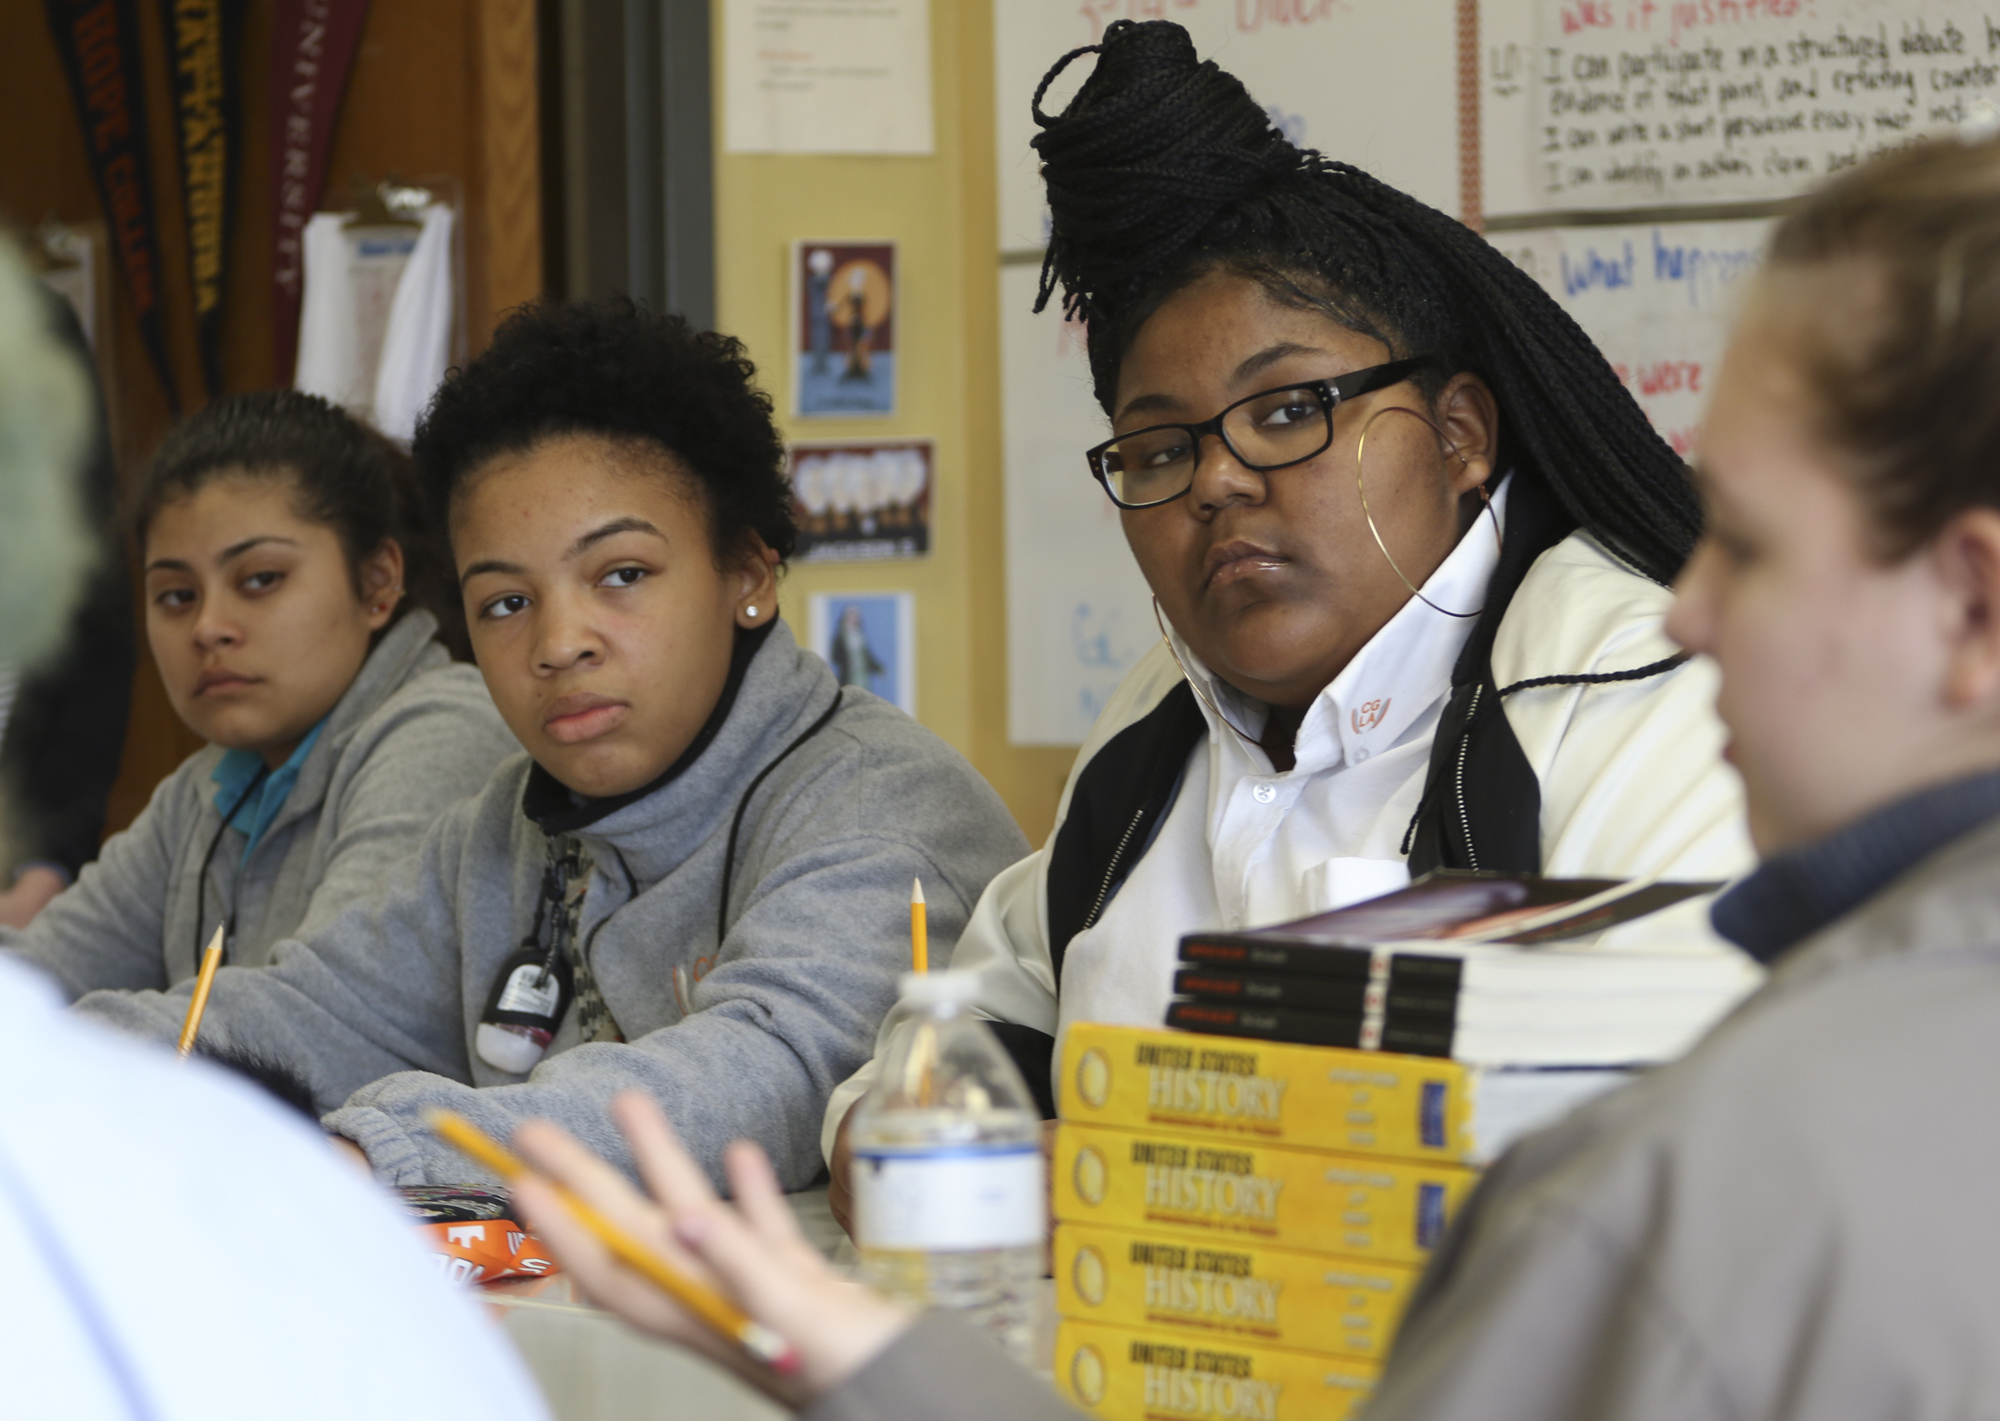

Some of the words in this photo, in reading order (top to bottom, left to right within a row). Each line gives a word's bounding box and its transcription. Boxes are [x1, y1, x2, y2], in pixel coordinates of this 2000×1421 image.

[1572, 51, 1611, 82] can
[1136, 1042, 1192, 1073] UNITED
[1198, 1048, 1259, 1077] STATES
[1148, 1066, 1286, 1121] HISTORY
[1131, 1141, 1187, 1173] UNITED
[1194, 1147, 1256, 1177] STATES
[1144, 1165, 1283, 1221] HISTORY
[1130, 1242, 1186, 1273] UNITED
[1192, 1248, 1253, 1277] STATES
[1144, 1265, 1281, 1323] HISTORY
[1130, 1341, 1186, 1373] UNITED
[1192, 1347, 1253, 1378] STATES
[1143, 1364, 1281, 1420] HISTORY
